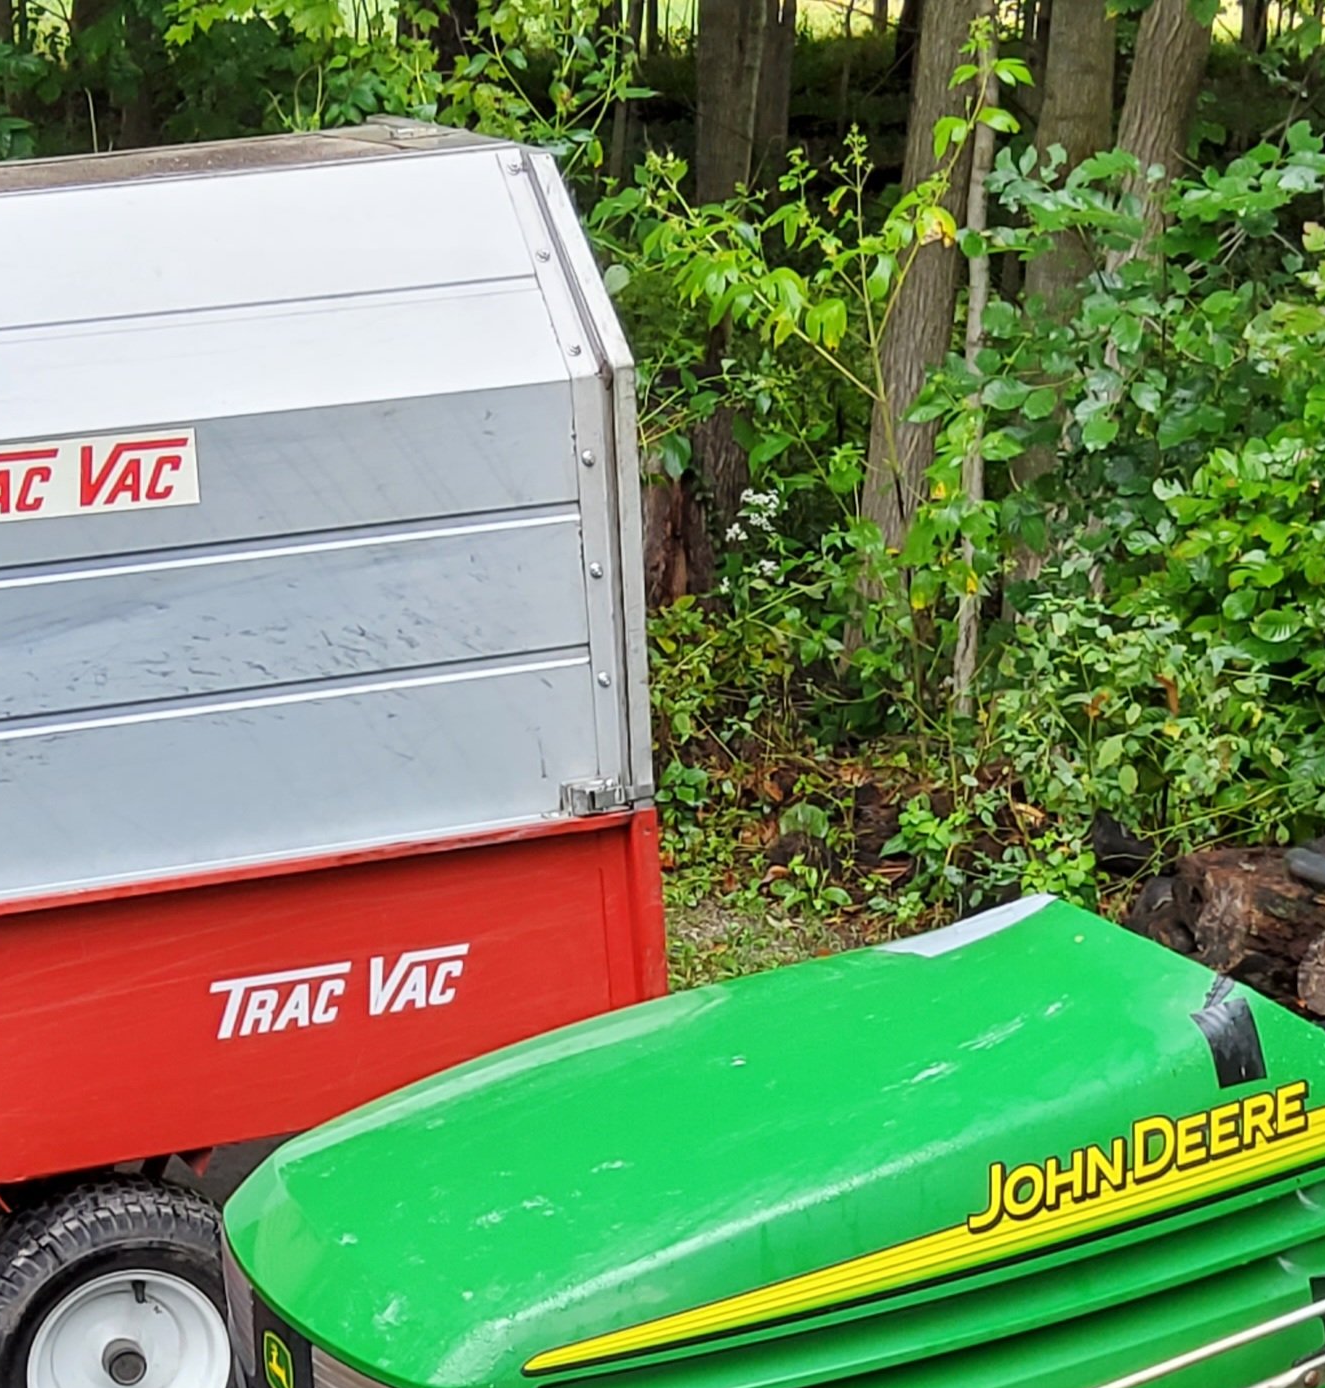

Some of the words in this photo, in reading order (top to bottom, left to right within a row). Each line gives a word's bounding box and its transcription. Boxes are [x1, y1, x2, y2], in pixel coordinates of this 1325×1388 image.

[78, 436, 190, 508] VAC
[209, 960, 352, 1041] TRAC
[367, 942, 470, 1017] VAC
[967, 1136, 1128, 1234] JOHN
[1128, 1080, 1310, 1185] DEERE
